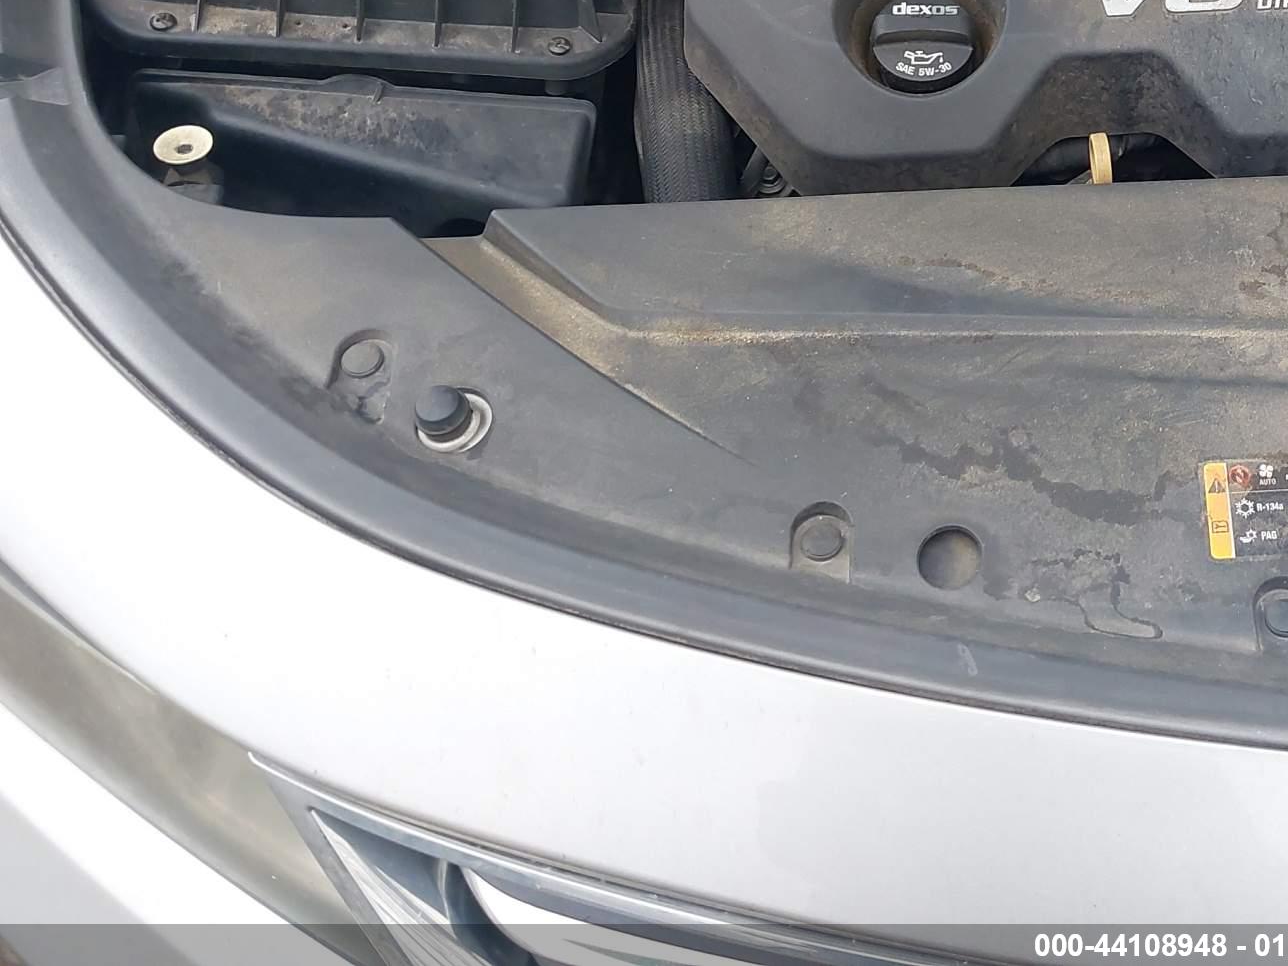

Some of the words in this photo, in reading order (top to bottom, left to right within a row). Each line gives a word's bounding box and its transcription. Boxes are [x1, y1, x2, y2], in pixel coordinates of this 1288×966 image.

[892, 1, 960, 16] dexos
[895, 61, 915, 76] SAE
[918, 61, 952, 76] 5W-30
[1256, 501, 1283, 511] R-134a
[1261, 530, 1278, 540] PAG
